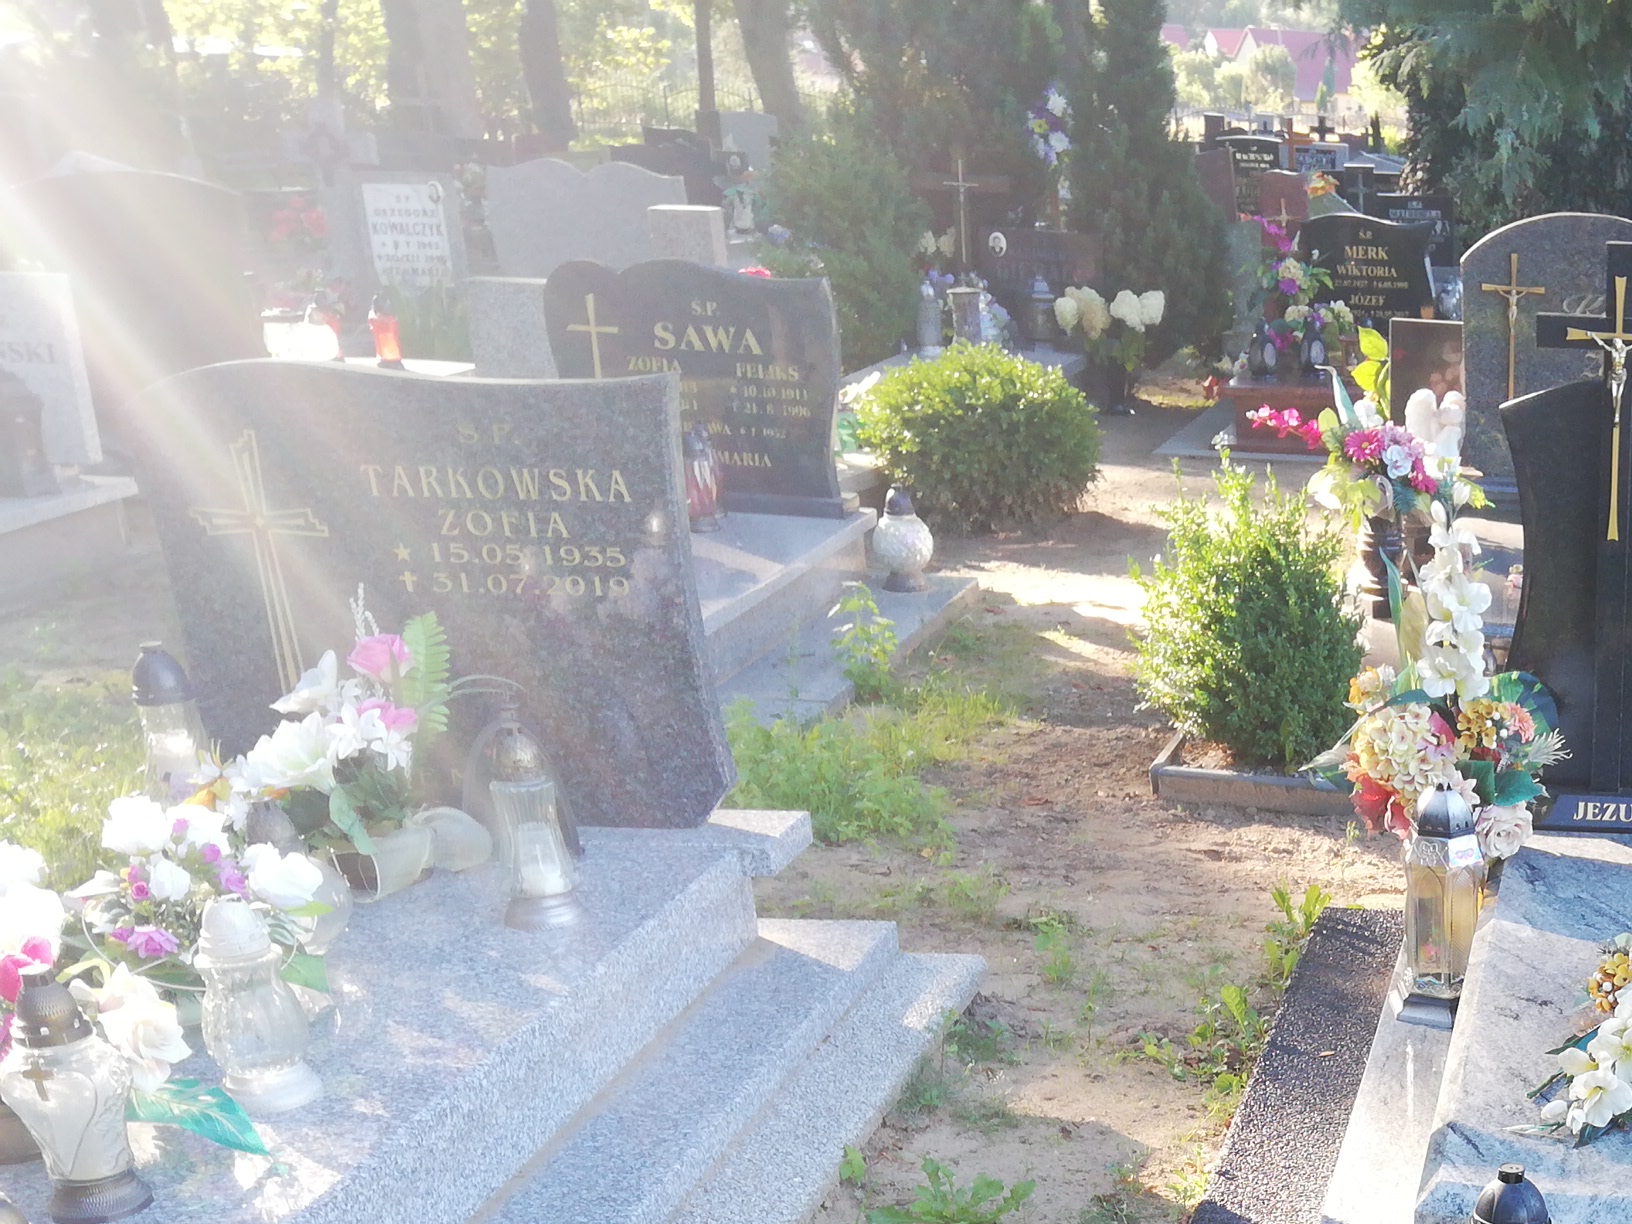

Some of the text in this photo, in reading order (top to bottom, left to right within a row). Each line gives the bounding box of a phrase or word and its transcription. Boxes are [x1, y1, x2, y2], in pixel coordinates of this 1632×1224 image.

[371, 221, 444, 236] KOWALCZYK
[1344, 246, 1389, 260] MERK
[1336, 264, 1398, 278] WIKTORIA
[1349, 292, 1386, 306] JÓZEF
[653, 321, 763, 357] SAWA
[626, 355, 682, 372] ZOFIA
[360, 464, 633, 503] TARKOWSKA
[438, 509, 570, 538] ZOFIA
[432, 572, 630, 597] 31.07.2019
